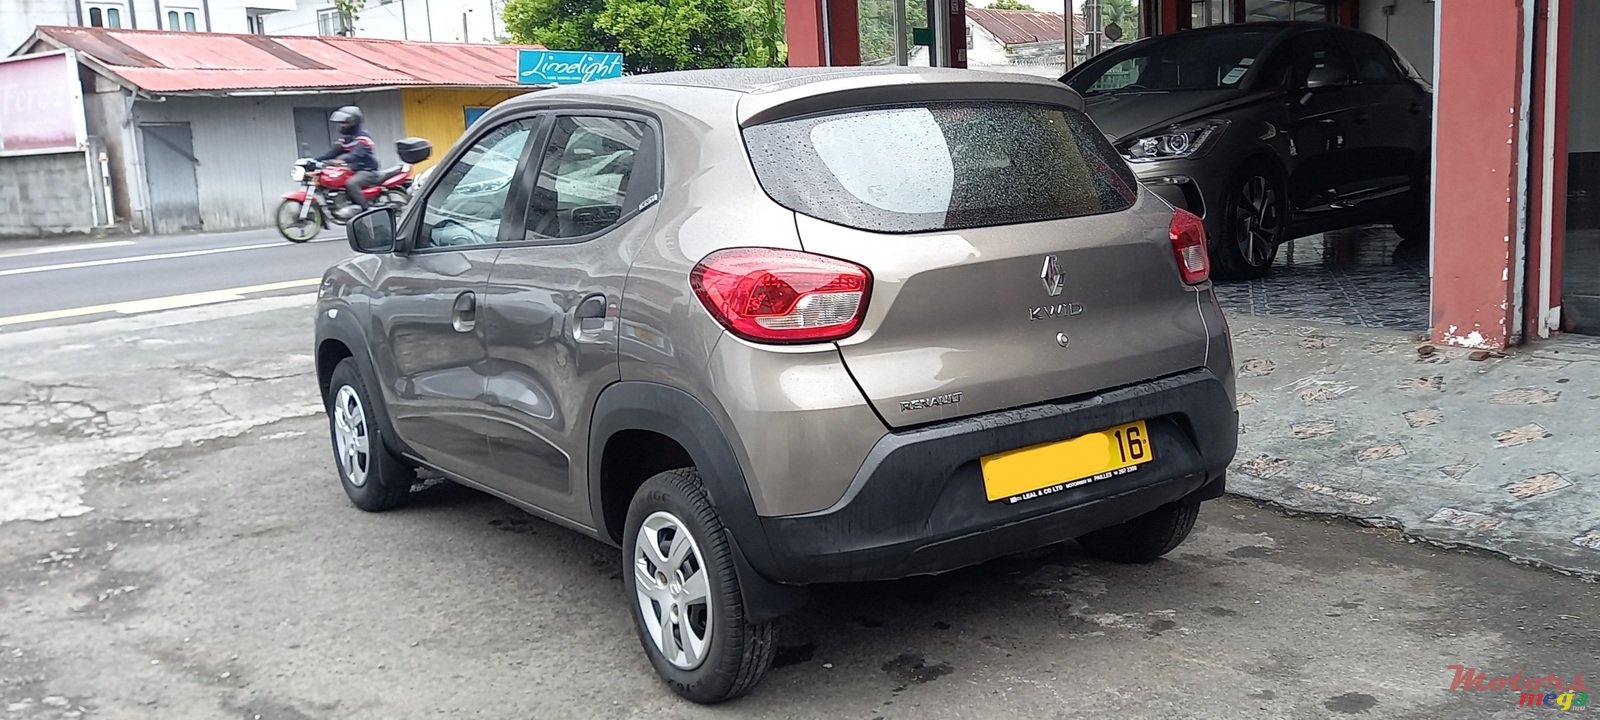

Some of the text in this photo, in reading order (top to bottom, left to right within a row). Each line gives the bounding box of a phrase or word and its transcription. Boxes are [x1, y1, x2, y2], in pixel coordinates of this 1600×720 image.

[522, 52, 620, 83] Limelight
[1028, 303, 1083, 321] KWID
[900, 391, 962, 411] RENAULT
[1114, 426, 1144, 463] 16
[1052, 484, 1063, 492] LTD
